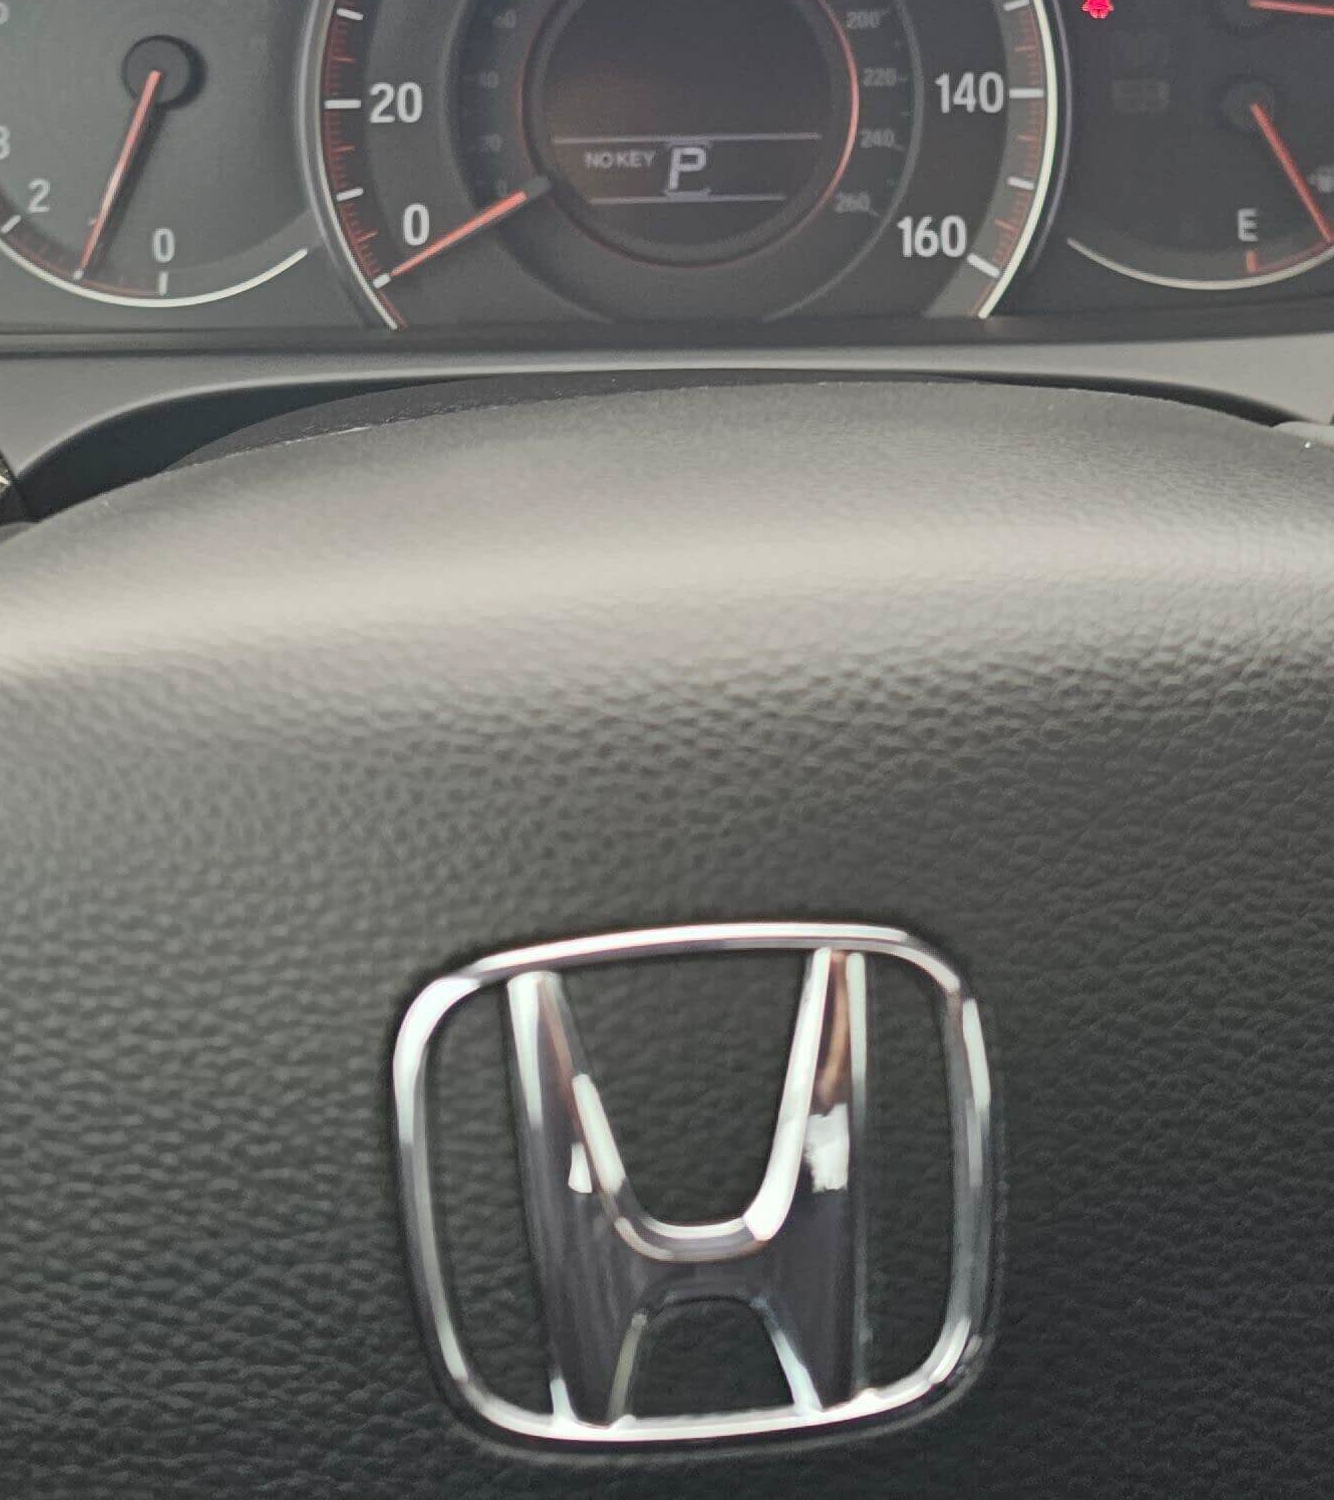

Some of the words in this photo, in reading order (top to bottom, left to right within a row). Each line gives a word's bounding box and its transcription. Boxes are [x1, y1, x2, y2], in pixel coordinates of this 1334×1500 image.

[371, 83, 422, 123] 20
[936, 73, 1003, 113] 140
[585, 150, 612, 169] NO
[616, 149, 656, 168] KEY
[669, 146, 707, 191] P
[28, 179, 51, 213] 2
[152, 227, 175, 262] 0
[403, 205, 430, 245] 0
[898, 217, 966, 257] 160
[1237, 208, 1258, 241] E
